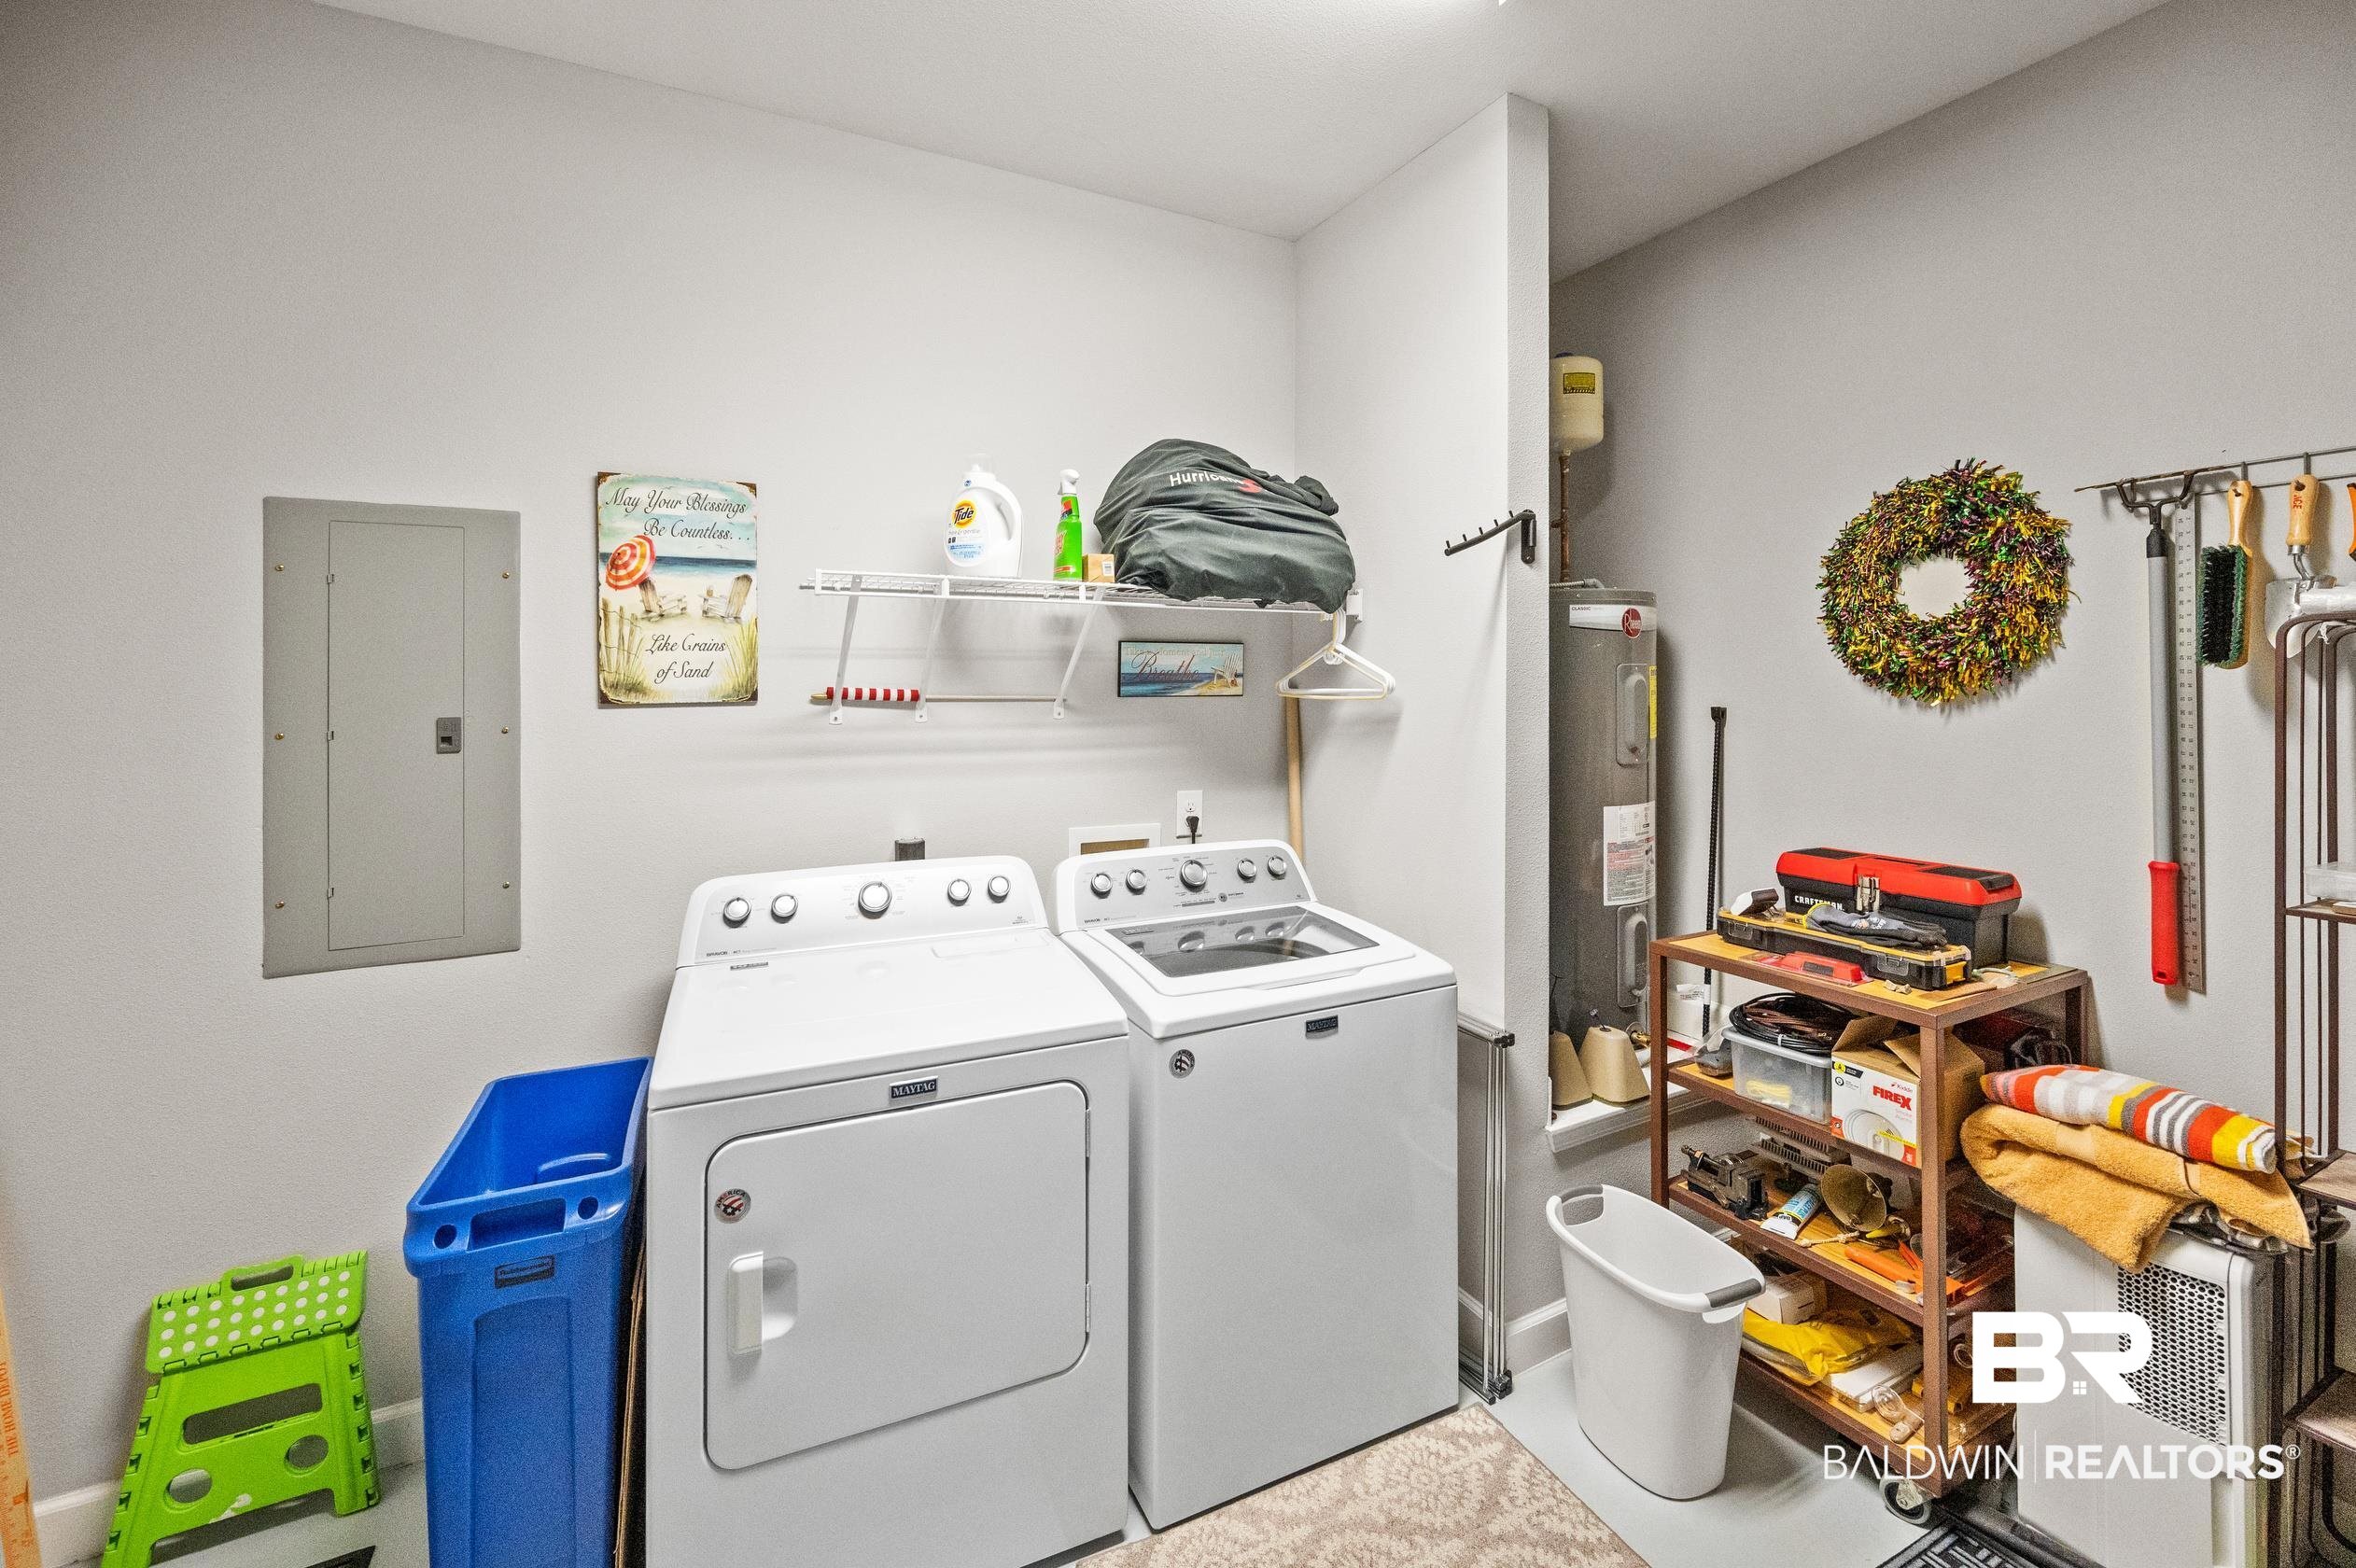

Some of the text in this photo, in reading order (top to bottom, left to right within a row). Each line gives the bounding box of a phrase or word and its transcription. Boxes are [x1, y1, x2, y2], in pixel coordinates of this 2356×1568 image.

[606, 487, 748, 519] May Your Blessings
[954, 507, 975, 525] Tide
[644, 517, 667, 538] Be
[645, 633, 726, 654] Like Grains
[654, 661, 714, 684] of Sand
[1131, 651, 1200, 679] Breathe
[1794, 895, 1844, 910] CRAFTAN
[892, 1081, 935, 1097] MAYTAG
[1872, 1085, 1912, 1111] FIREX
